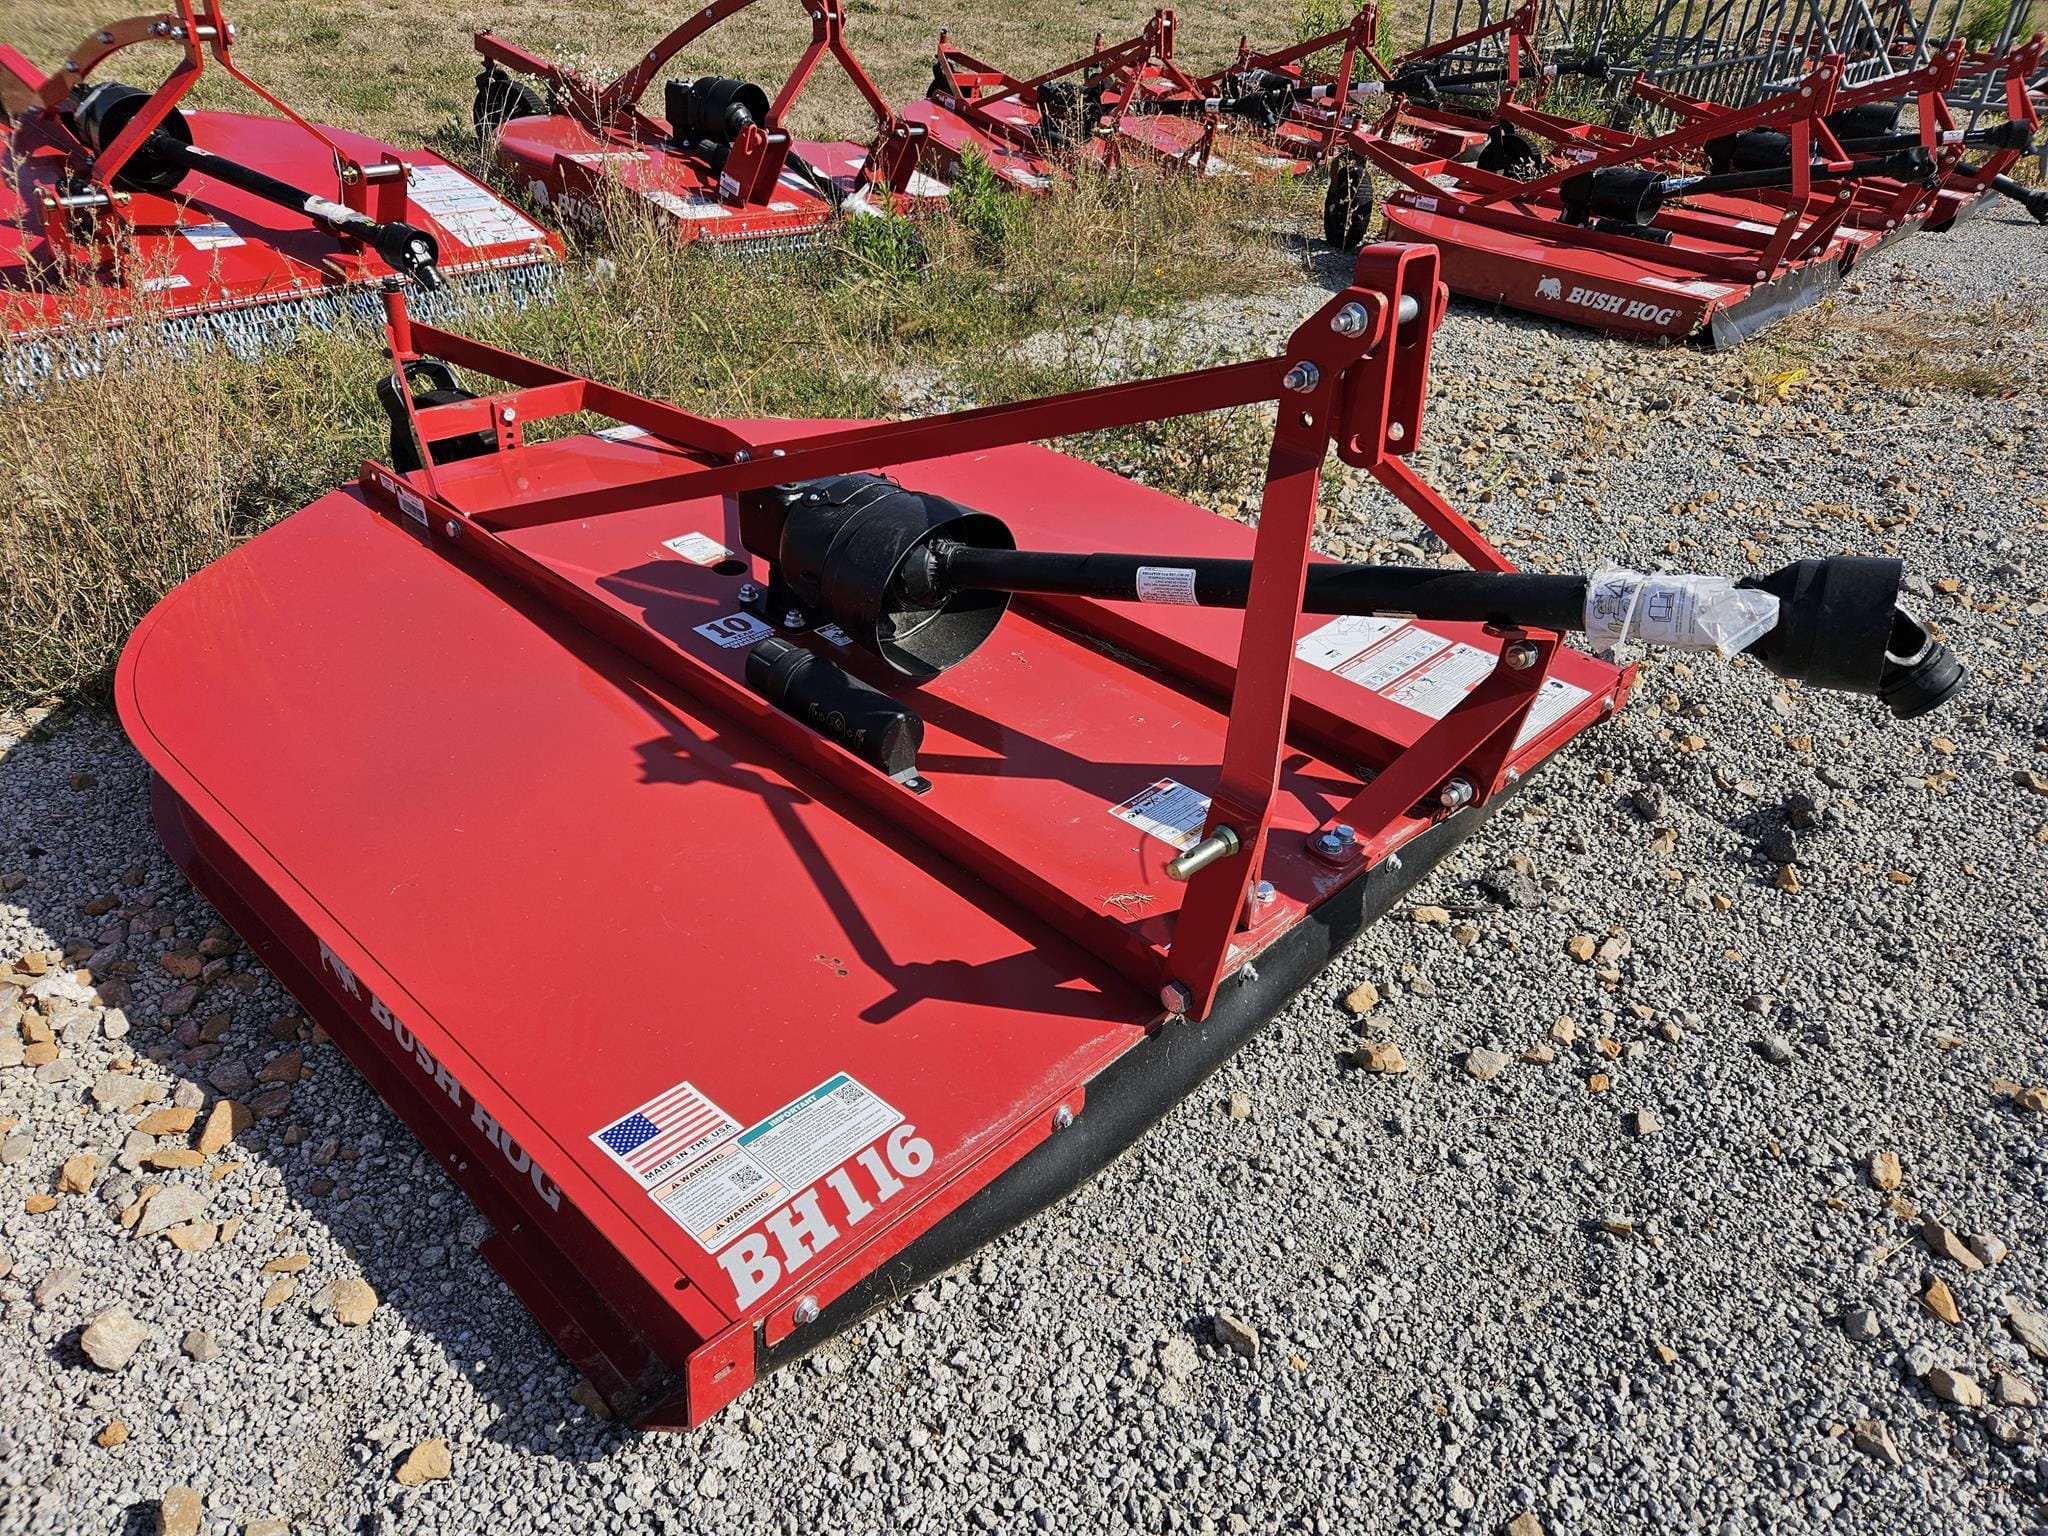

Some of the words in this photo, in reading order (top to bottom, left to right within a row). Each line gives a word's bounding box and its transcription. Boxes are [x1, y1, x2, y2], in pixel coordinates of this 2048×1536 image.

[1565, 287, 1626, 314] BUSH
[706, 618, 752, 638] 10
[768, 1094, 818, 1127] IMPORTANT
[642, 1158, 675, 1180] MADE
[675, 1150, 688, 1160] IN
[688, 1136, 710, 1151] THE
[710, 1122, 732, 1137] USA
[680, 1154, 725, 1183] WARNING
[716, 1125, 935, 1312] BH116
[724, 1192, 769, 1224] WARNING
